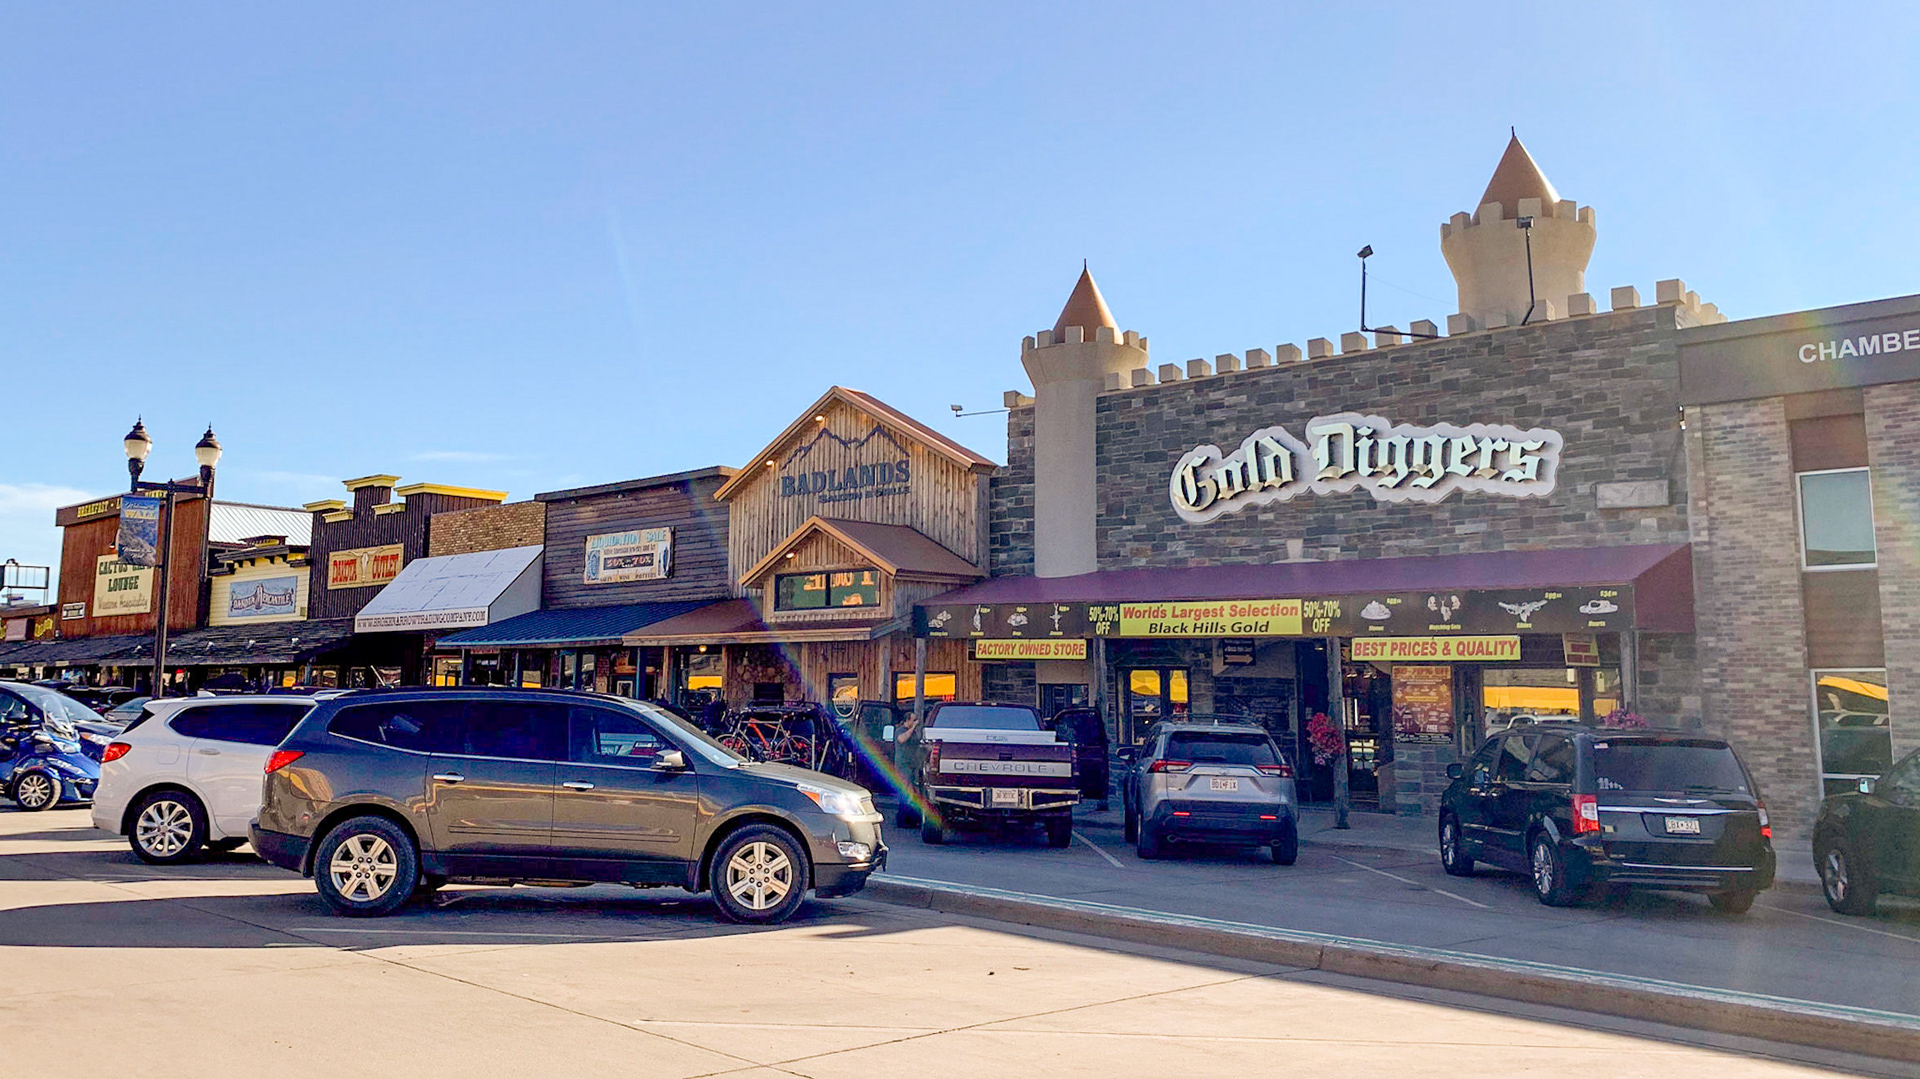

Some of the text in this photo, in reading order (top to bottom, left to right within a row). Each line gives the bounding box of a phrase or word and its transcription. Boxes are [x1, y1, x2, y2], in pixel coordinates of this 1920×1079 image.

[1798, 328, 1920, 364] CHAMBE
[1173, 421, 1546, 512] Gold Diggers
[781, 459, 911, 498] BADLANDS
[591, 529, 667, 550] LIQUIDATION SALE
[372, 554, 399, 580] OUTLET
[107, 576, 139, 593] LOUNGE
[1171, 604, 1225, 622] Largest
[1228, 603, 1299, 618] Selection
[1095, 621, 1111, 635] OFF
[1149, 620, 1270, 634] Black Hills Gold
[1312, 618, 1331, 633] OFF
[977, 643, 1085, 656] FACTORY OWNED STORE
[1353, 639, 1518, 657] BEST PRICES & QUALITY
